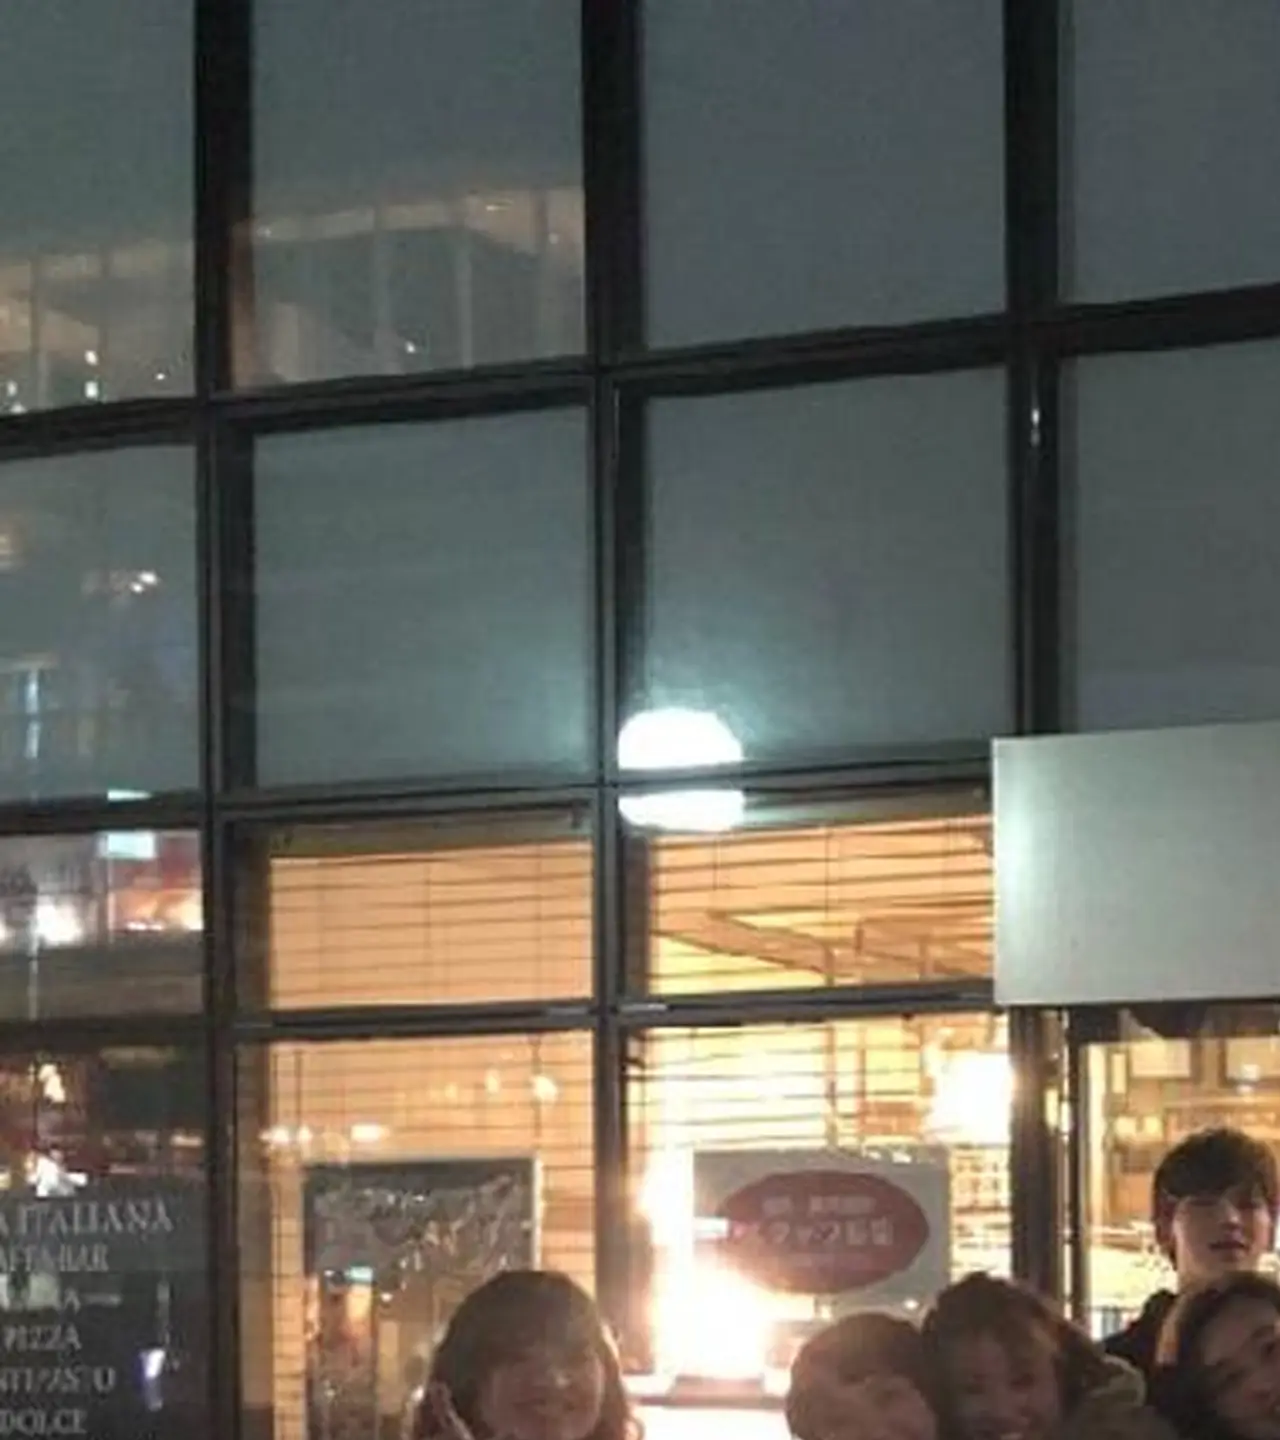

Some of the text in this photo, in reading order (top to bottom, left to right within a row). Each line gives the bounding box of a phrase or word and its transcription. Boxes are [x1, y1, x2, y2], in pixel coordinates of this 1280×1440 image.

[16, 1199, 174, 1236] ITALIANA
[3, 1322, 82, 1351] PIZZA
[0, 1406, 88, 1435] DOLCE
